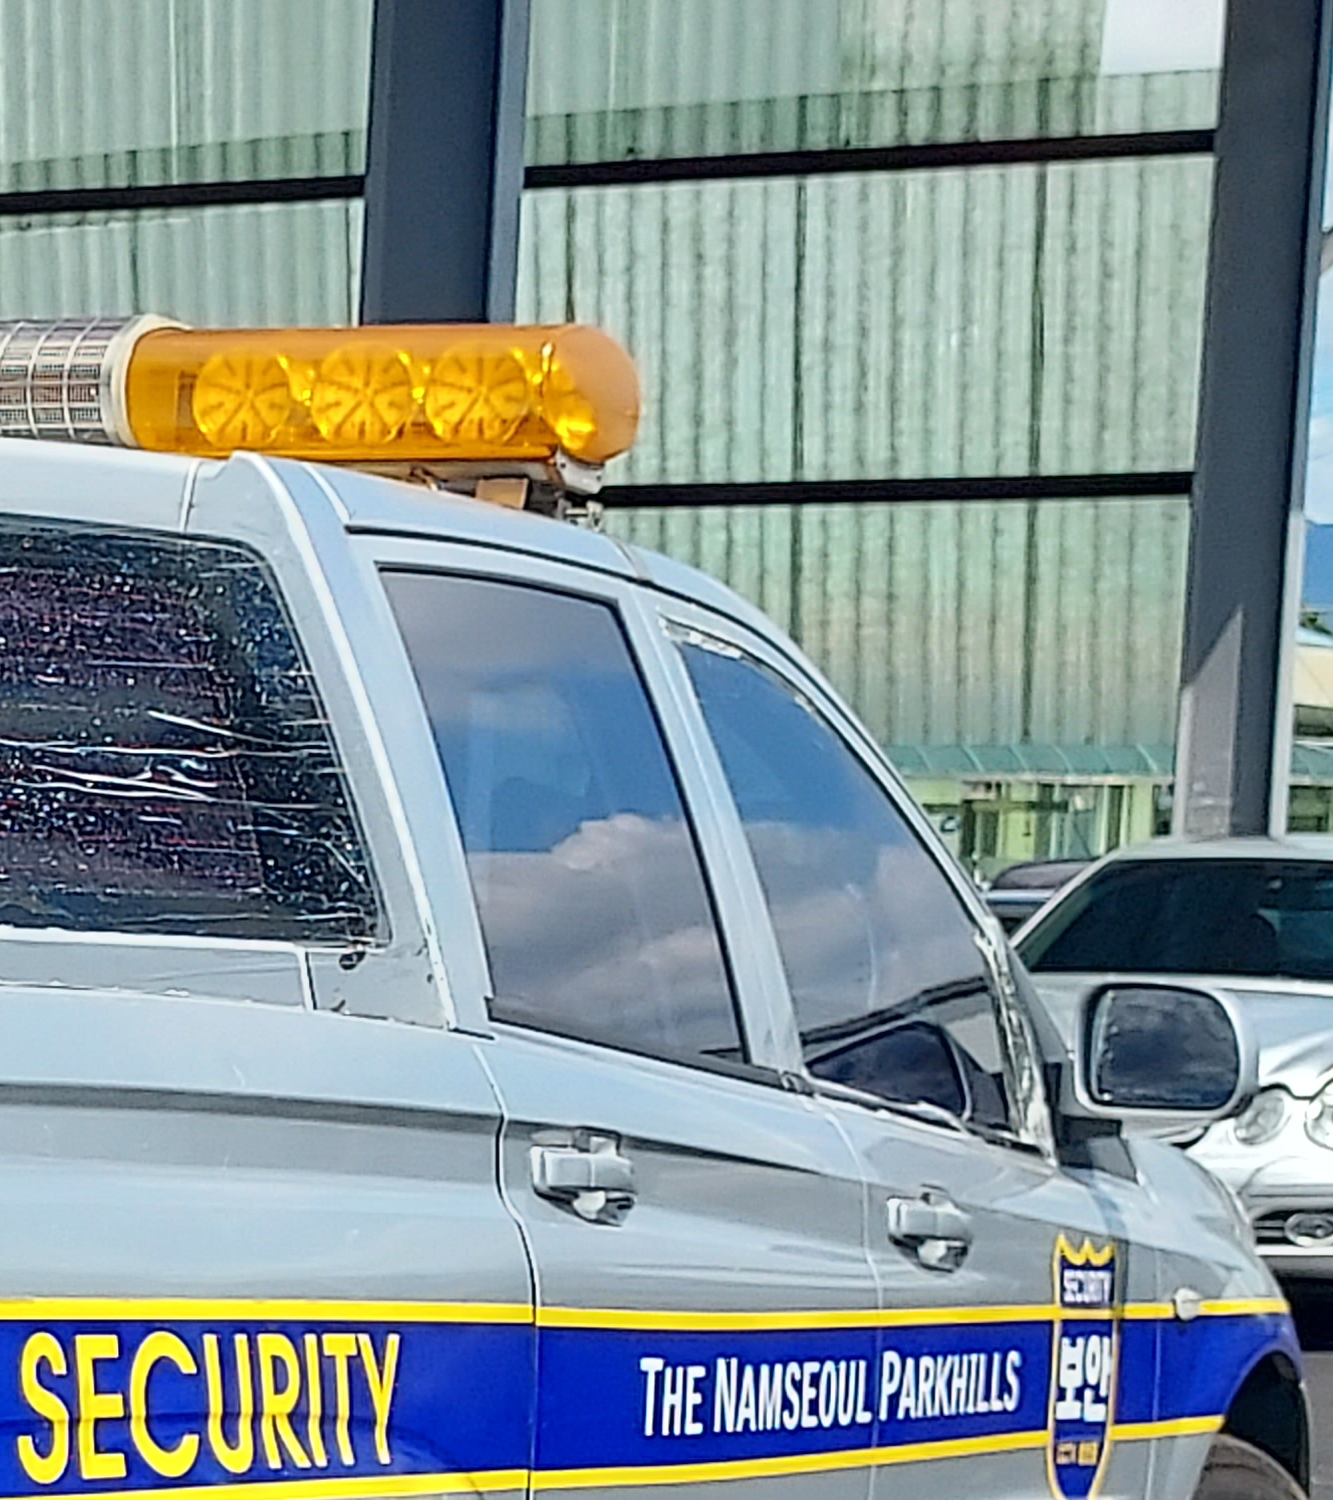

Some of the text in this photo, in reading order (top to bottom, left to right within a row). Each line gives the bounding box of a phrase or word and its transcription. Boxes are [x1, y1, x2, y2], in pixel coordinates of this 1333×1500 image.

[16, 1330, 401, 1485] SECURITY
[639, 1349, 1023, 1437] THE NAMSEOUL PARKHILLS
[1054, 1333, 1113, 1423] 보안
